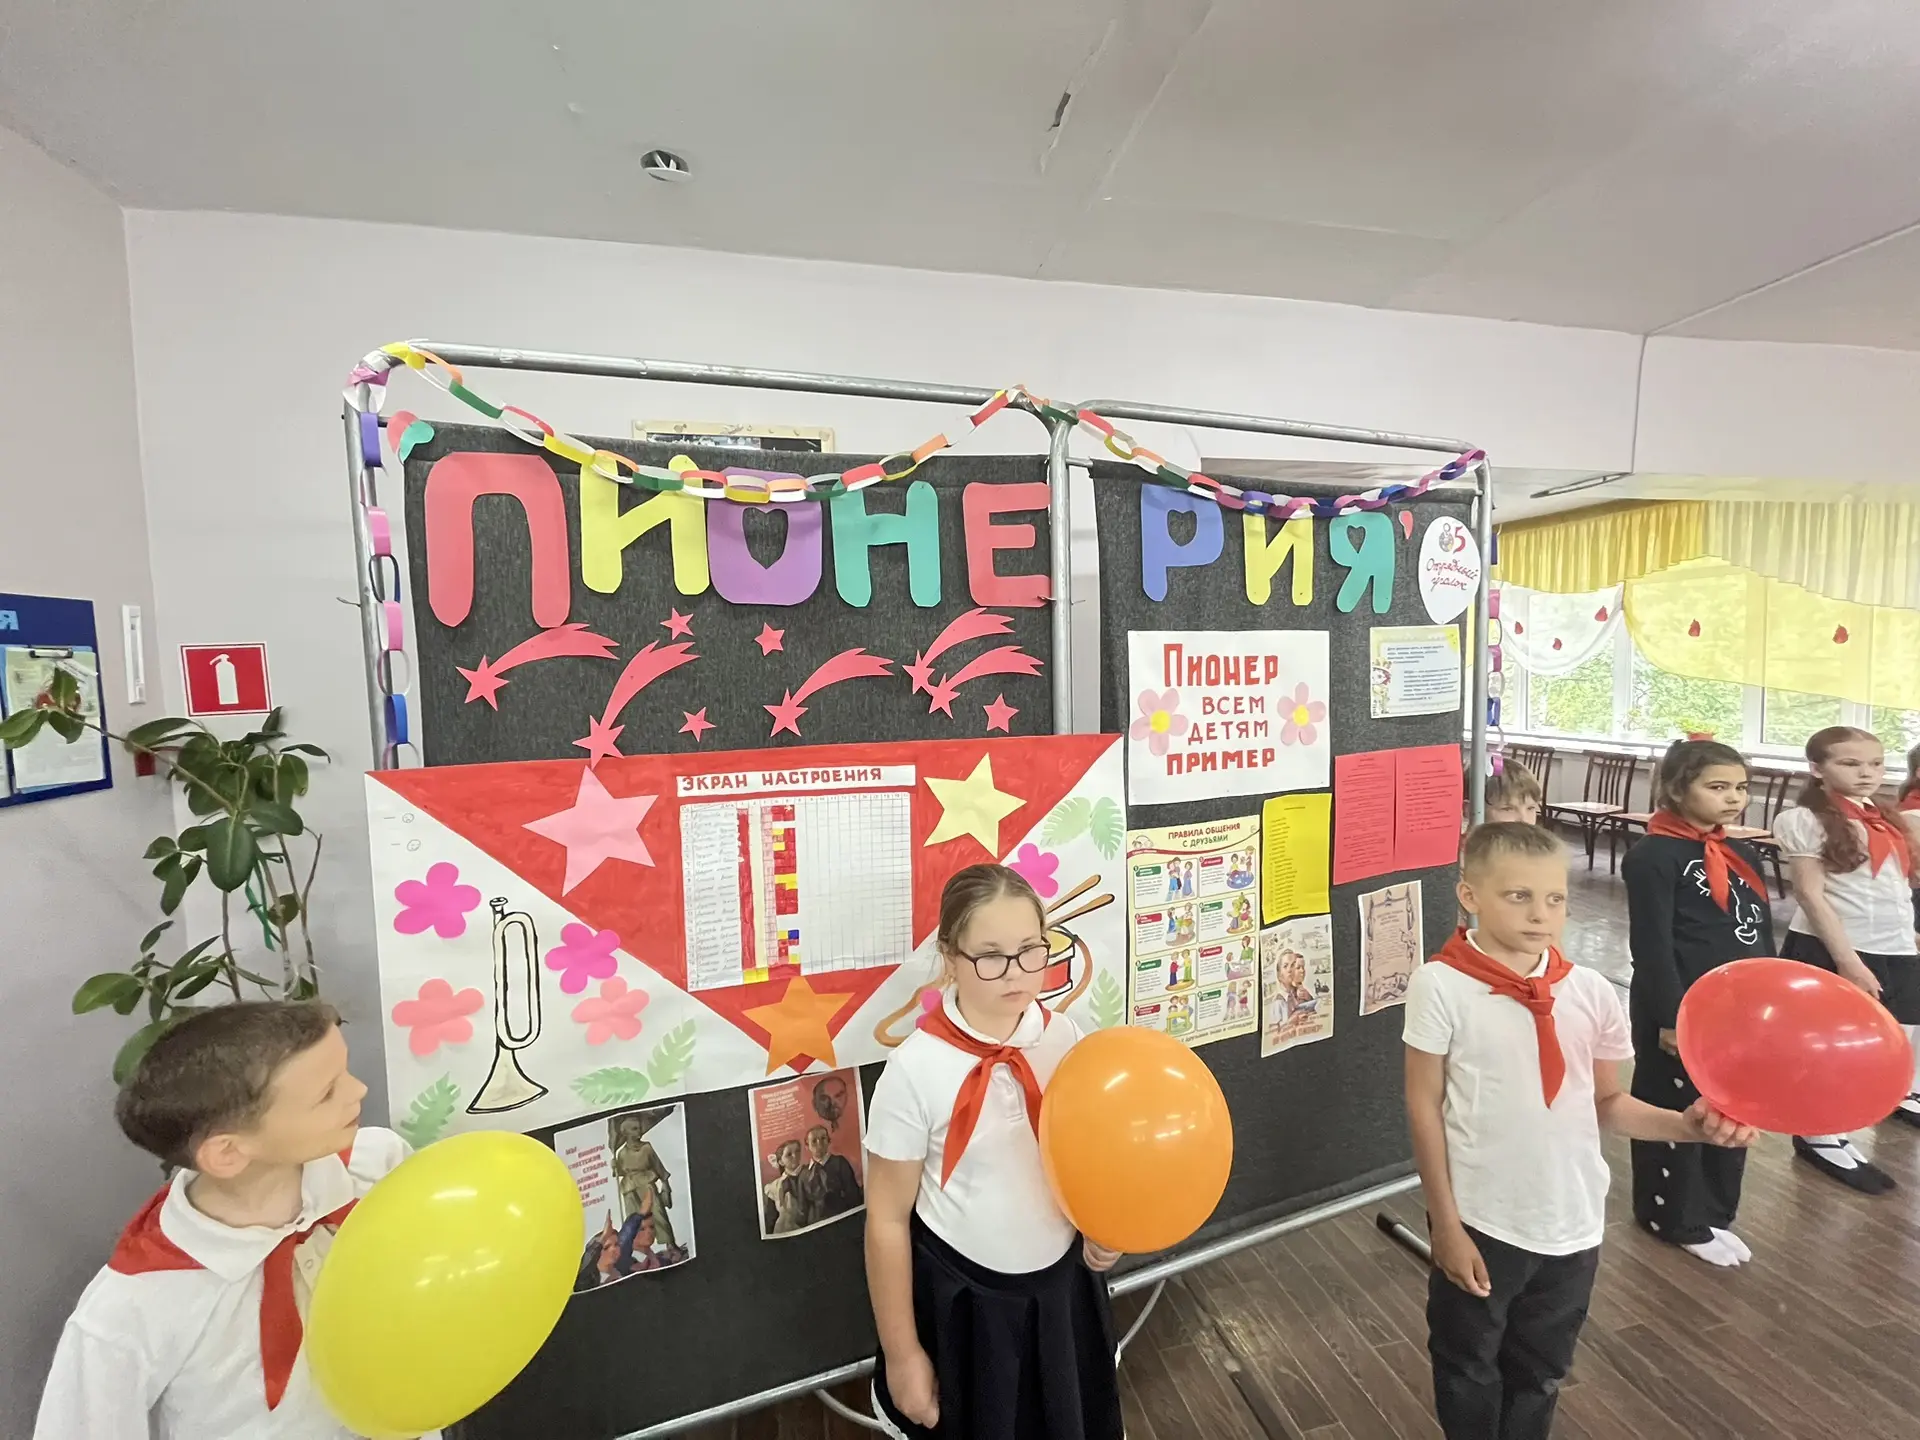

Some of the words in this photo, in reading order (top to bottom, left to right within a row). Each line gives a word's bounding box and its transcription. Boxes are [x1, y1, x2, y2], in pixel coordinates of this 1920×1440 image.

[1202, 695, 1265, 716] ВСЕМ
[1187, 720, 1269, 746] ДЕТЯМ
[1166, 747, 1276, 776] ПРИМЕР
[682, 773, 748, 791] ЭКРАН
[762, 767, 883, 786] НАСТРОЕНИЯ
[1168, 828, 1203, 840] ПРАВИЛА
[1205, 823, 1240, 835] ОБЩЕНИЯ
[1190, 834, 1228, 848] ДРУЗЬЯМИ
